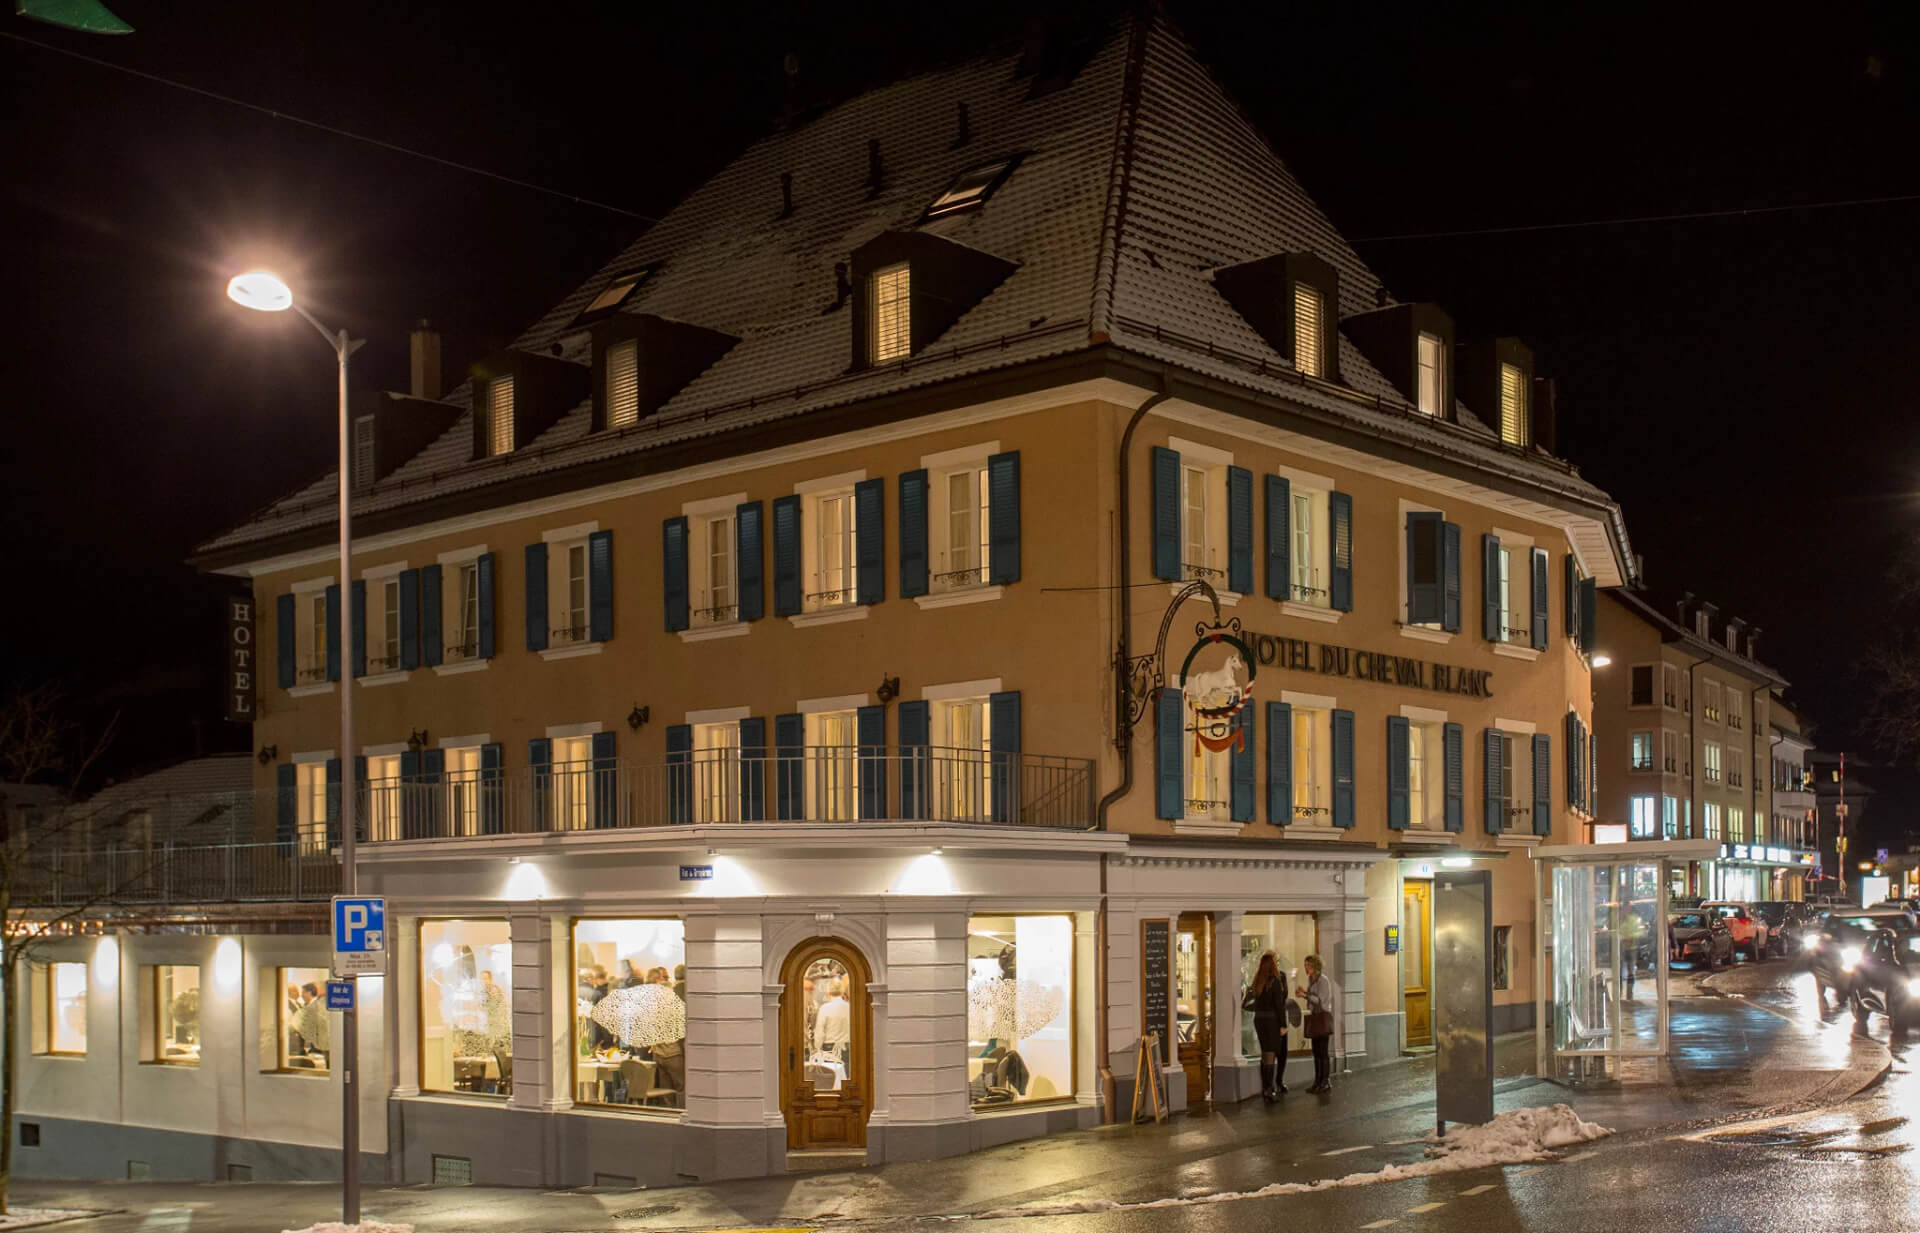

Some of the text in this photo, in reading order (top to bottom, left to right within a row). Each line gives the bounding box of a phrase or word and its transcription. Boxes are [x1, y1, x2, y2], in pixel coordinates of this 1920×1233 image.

[232, 603, 250, 713] HOTEL
[1320, 644, 1349, 676] DU
[1355, 650, 1428, 689] CHEVAL
[1433, 663, 1493, 698] BLANC
[344, 904, 368, 943] P
